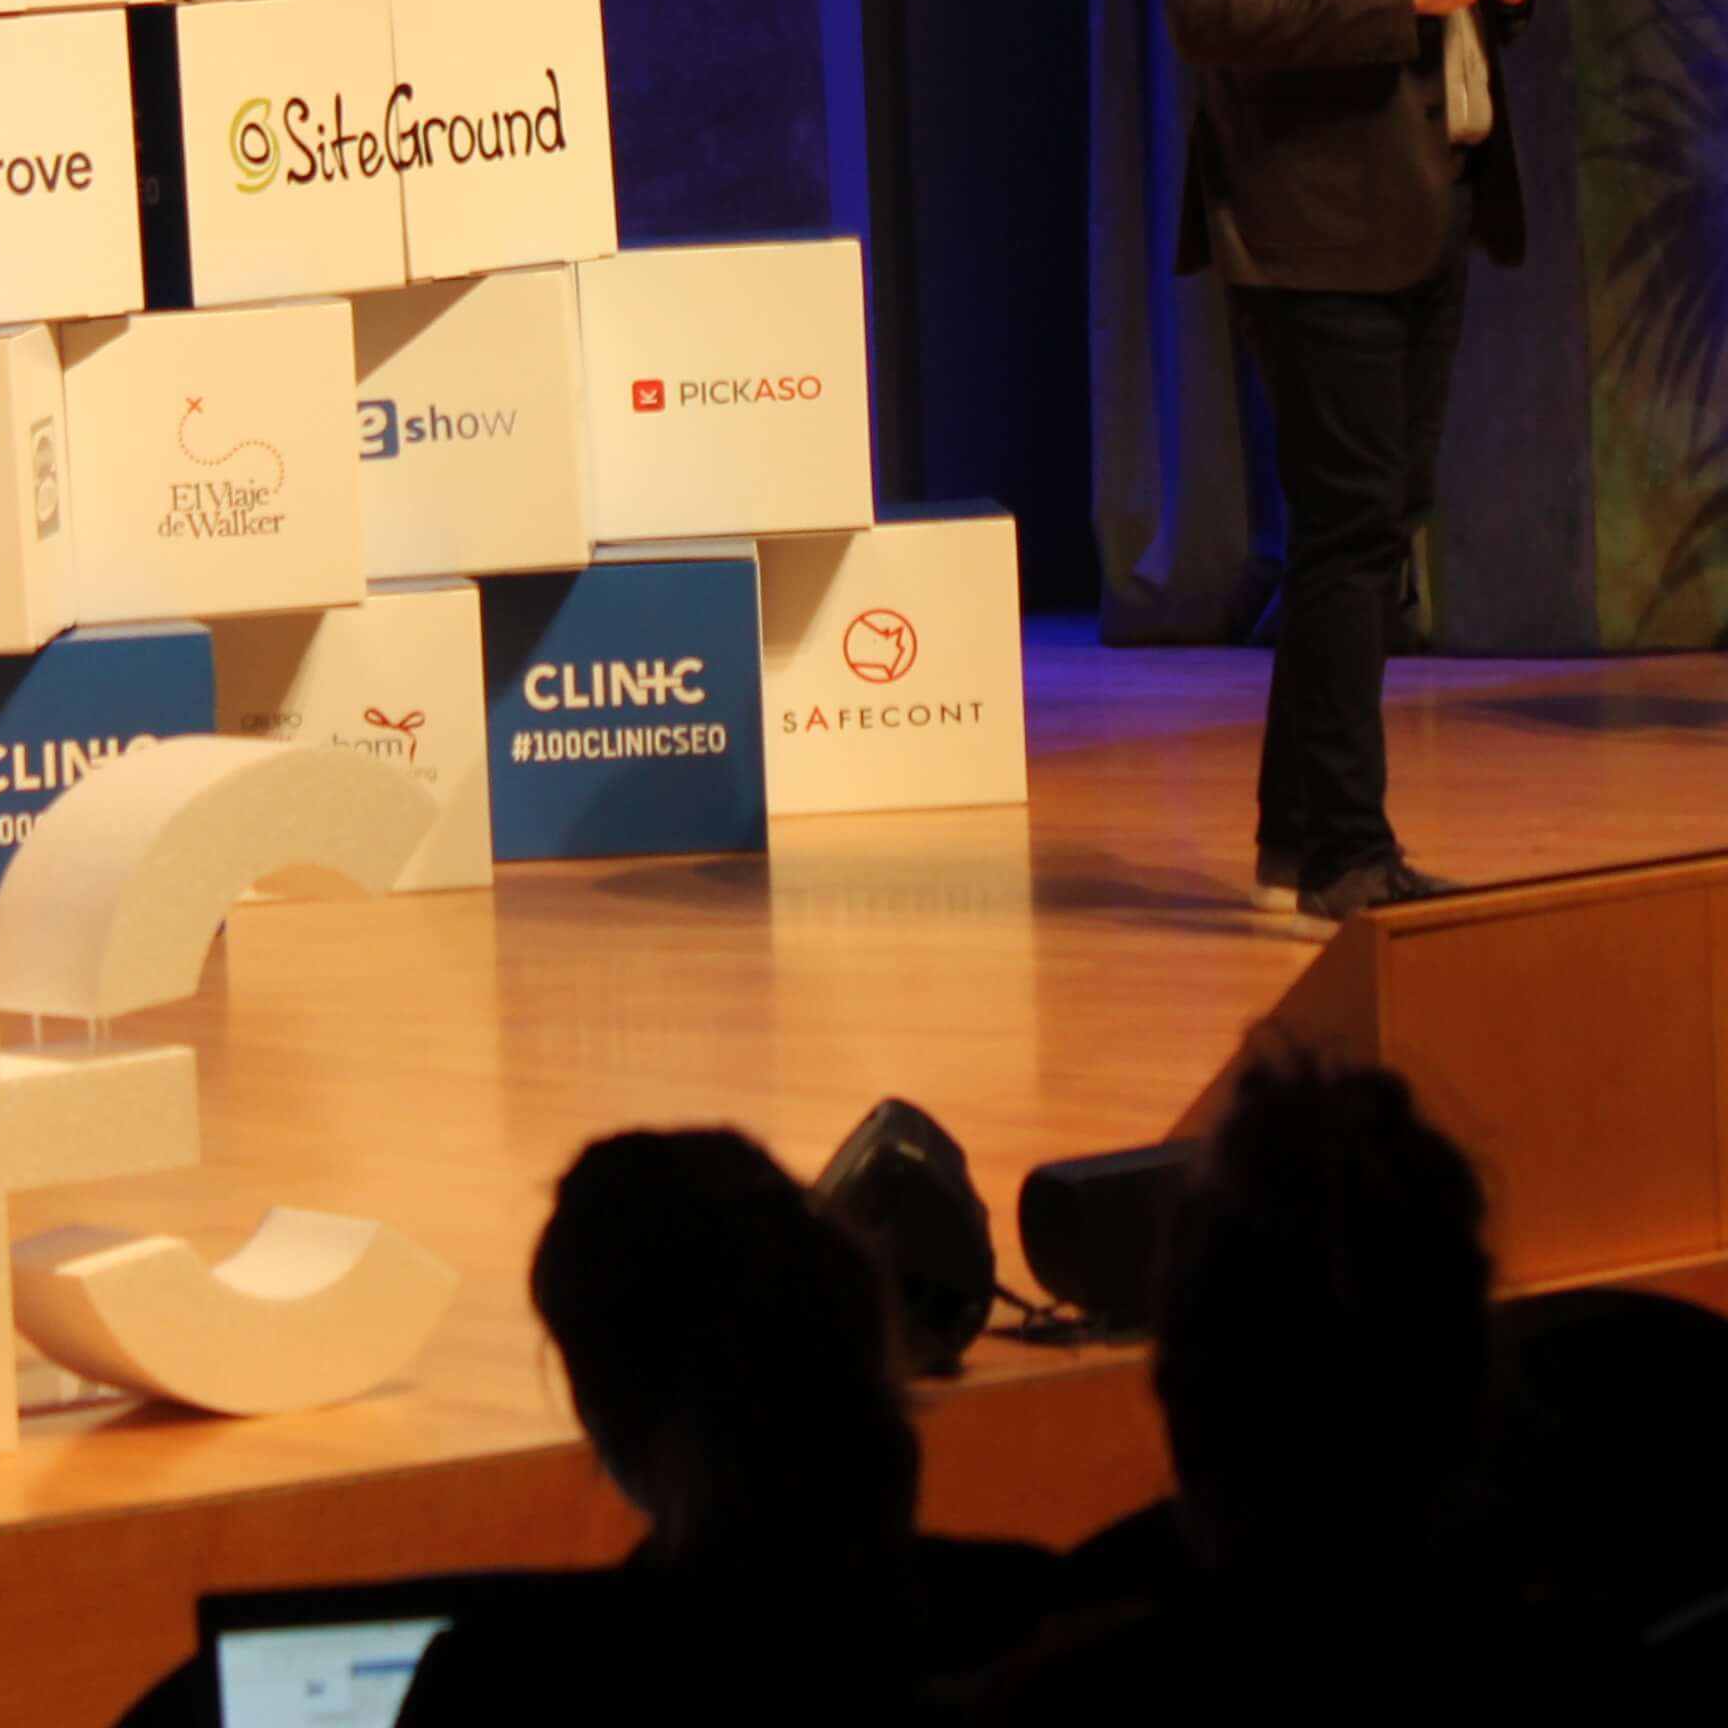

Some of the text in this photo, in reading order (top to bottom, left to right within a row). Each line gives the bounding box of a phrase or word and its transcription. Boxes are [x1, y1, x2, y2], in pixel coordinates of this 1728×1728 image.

[285, 68, 567, 186] SiteGround
[678, 374, 823, 409] PICKASO
[170, 483, 201, 513] El
[157, 508, 286, 539] de Walker
[782, 700, 985, 733] SAFECONT
[511, 722, 726, 764] #100CLINICSEO
